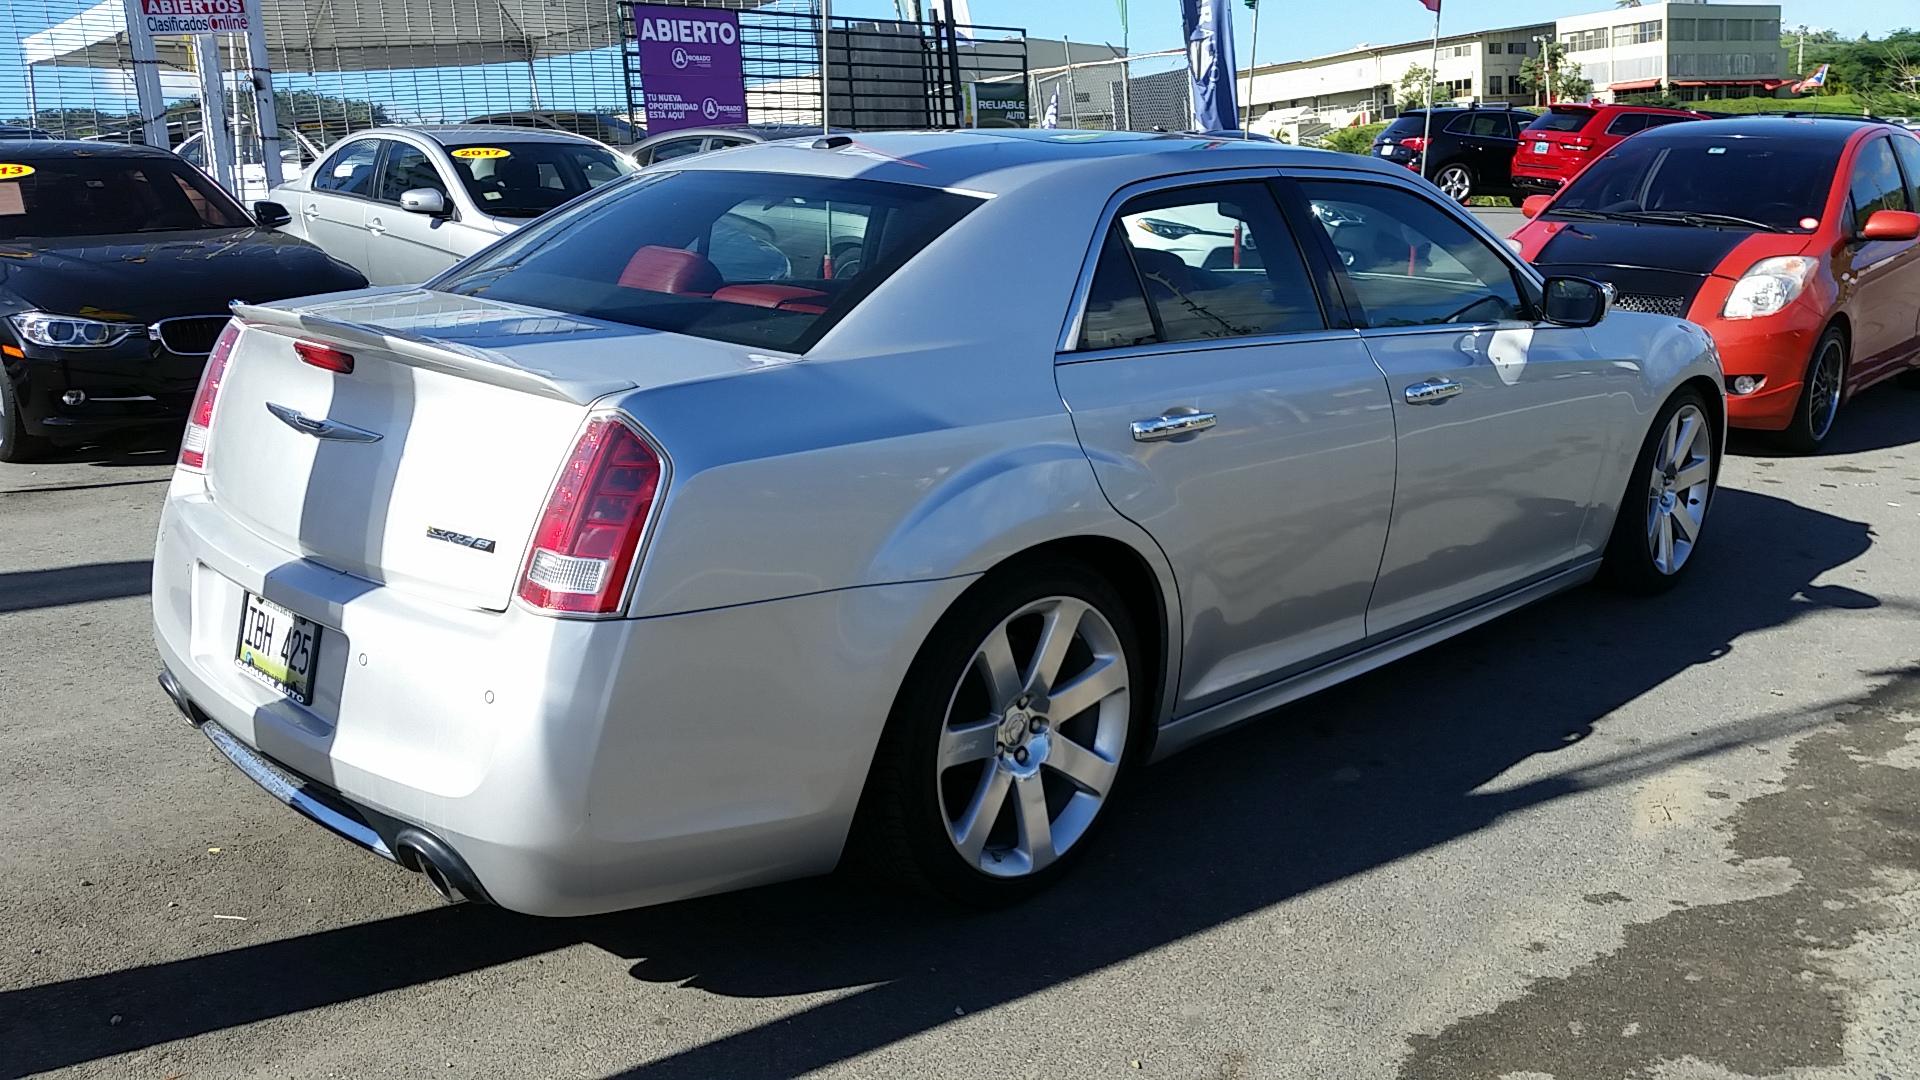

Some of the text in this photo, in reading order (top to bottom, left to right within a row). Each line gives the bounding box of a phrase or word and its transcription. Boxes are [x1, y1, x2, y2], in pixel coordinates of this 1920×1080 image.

[147, 0, 241, 14] ABIERTOS
[641, 18, 736, 45] ABIERTO
[648, 103, 698, 111] OPORTUNIDAD
[978, 101, 1025, 110] RELIABLE
[649, 111, 685, 120] ESTÁ AQUÍ
[1006, 111, 1026, 120] AUTO
[0, 166, 23, 175] 13
[244, 606, 275, 657] IBH
[280, 626, 312, 676] 425
[276, 683, 305, 704] AUTO
